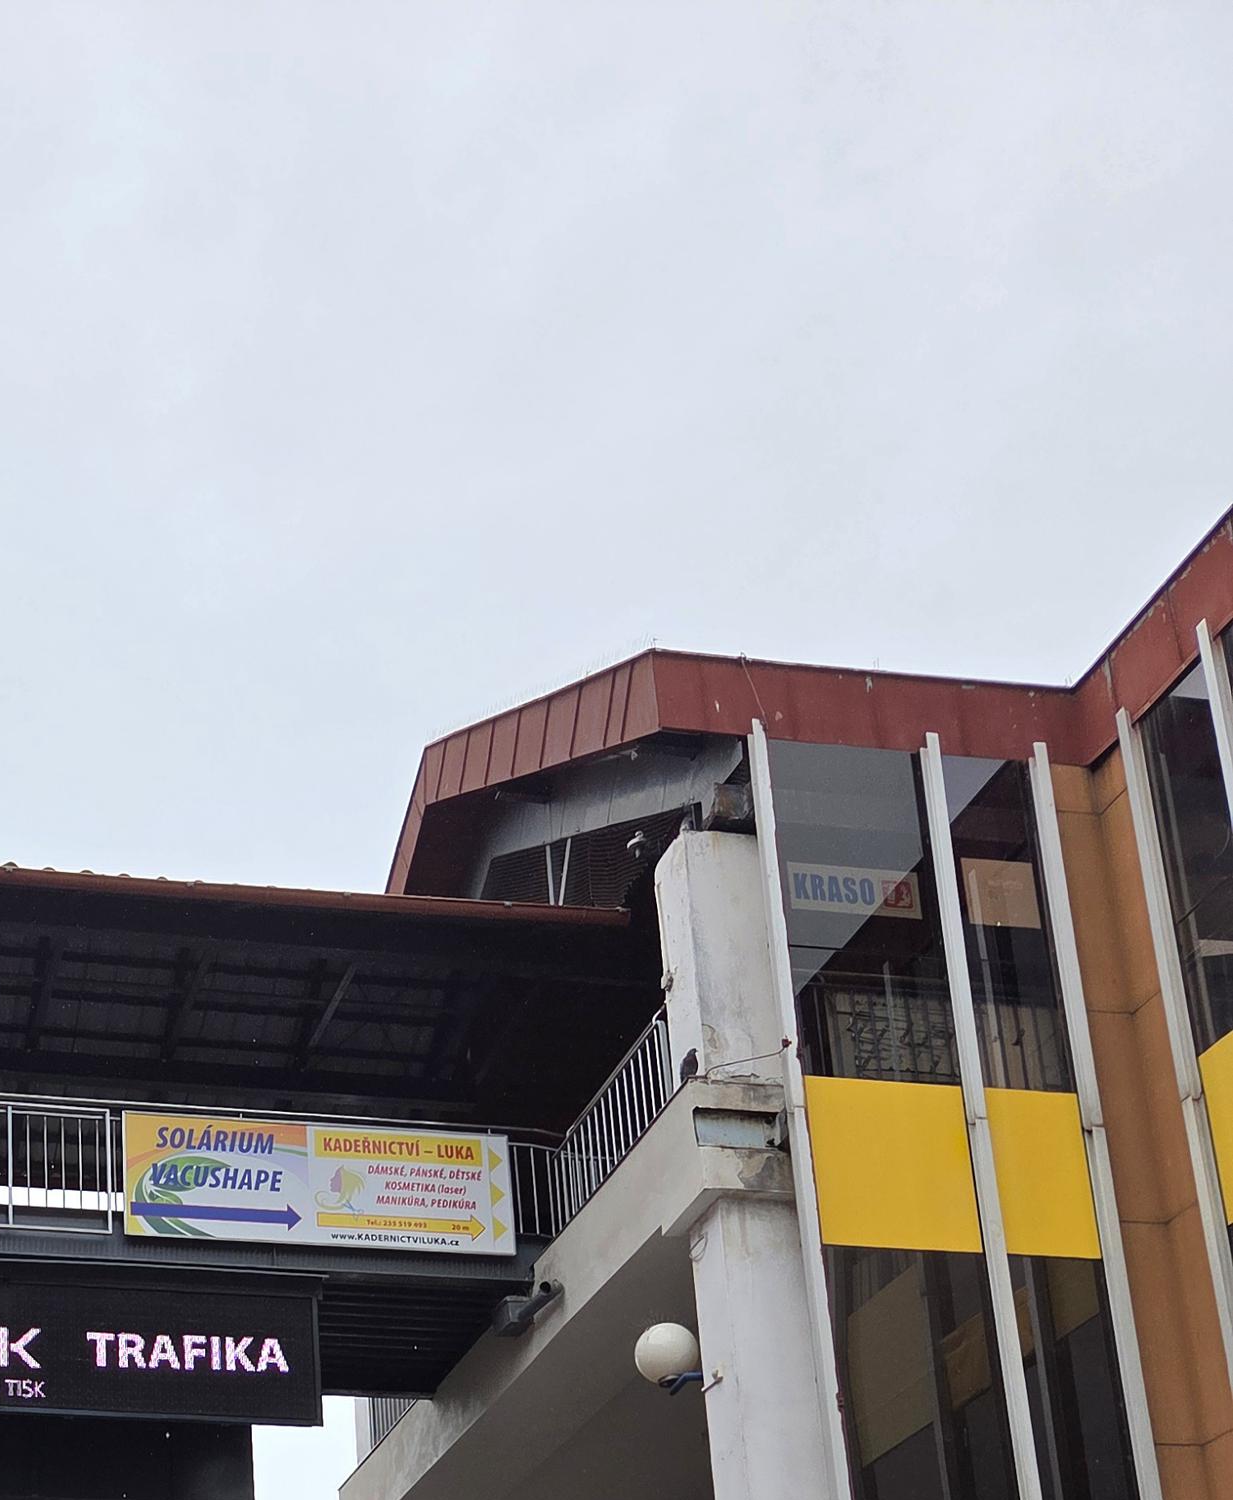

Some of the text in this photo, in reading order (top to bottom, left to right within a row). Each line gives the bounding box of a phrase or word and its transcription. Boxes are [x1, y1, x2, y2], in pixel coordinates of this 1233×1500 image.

[792, 872, 876, 906] KRASO
[156, 1125, 274, 1155] SOLÁRIUM
[323, 1137, 420, 1157] KADEŘNICTVÍ
[437, 1145, 474, 1160] LUKA
[151, 1163, 282, 1193] VACUSHAPE
[368, 1165, 482, 1181] DÁMSKÉ, PÁNSKÉ, DĚTSKÉ
[385, 1181, 467, 1195] KOSMETIKA (laser)
[376, 1195, 477, 1210] MANIKÚRA, PEDIKÚRA
[331, 1233, 459, 1246] www.KADERNICTVILUKA.cz
[86, 1331, 289, 1373] TRAFIKA
[4, 1378, 46, 1400] TISK
